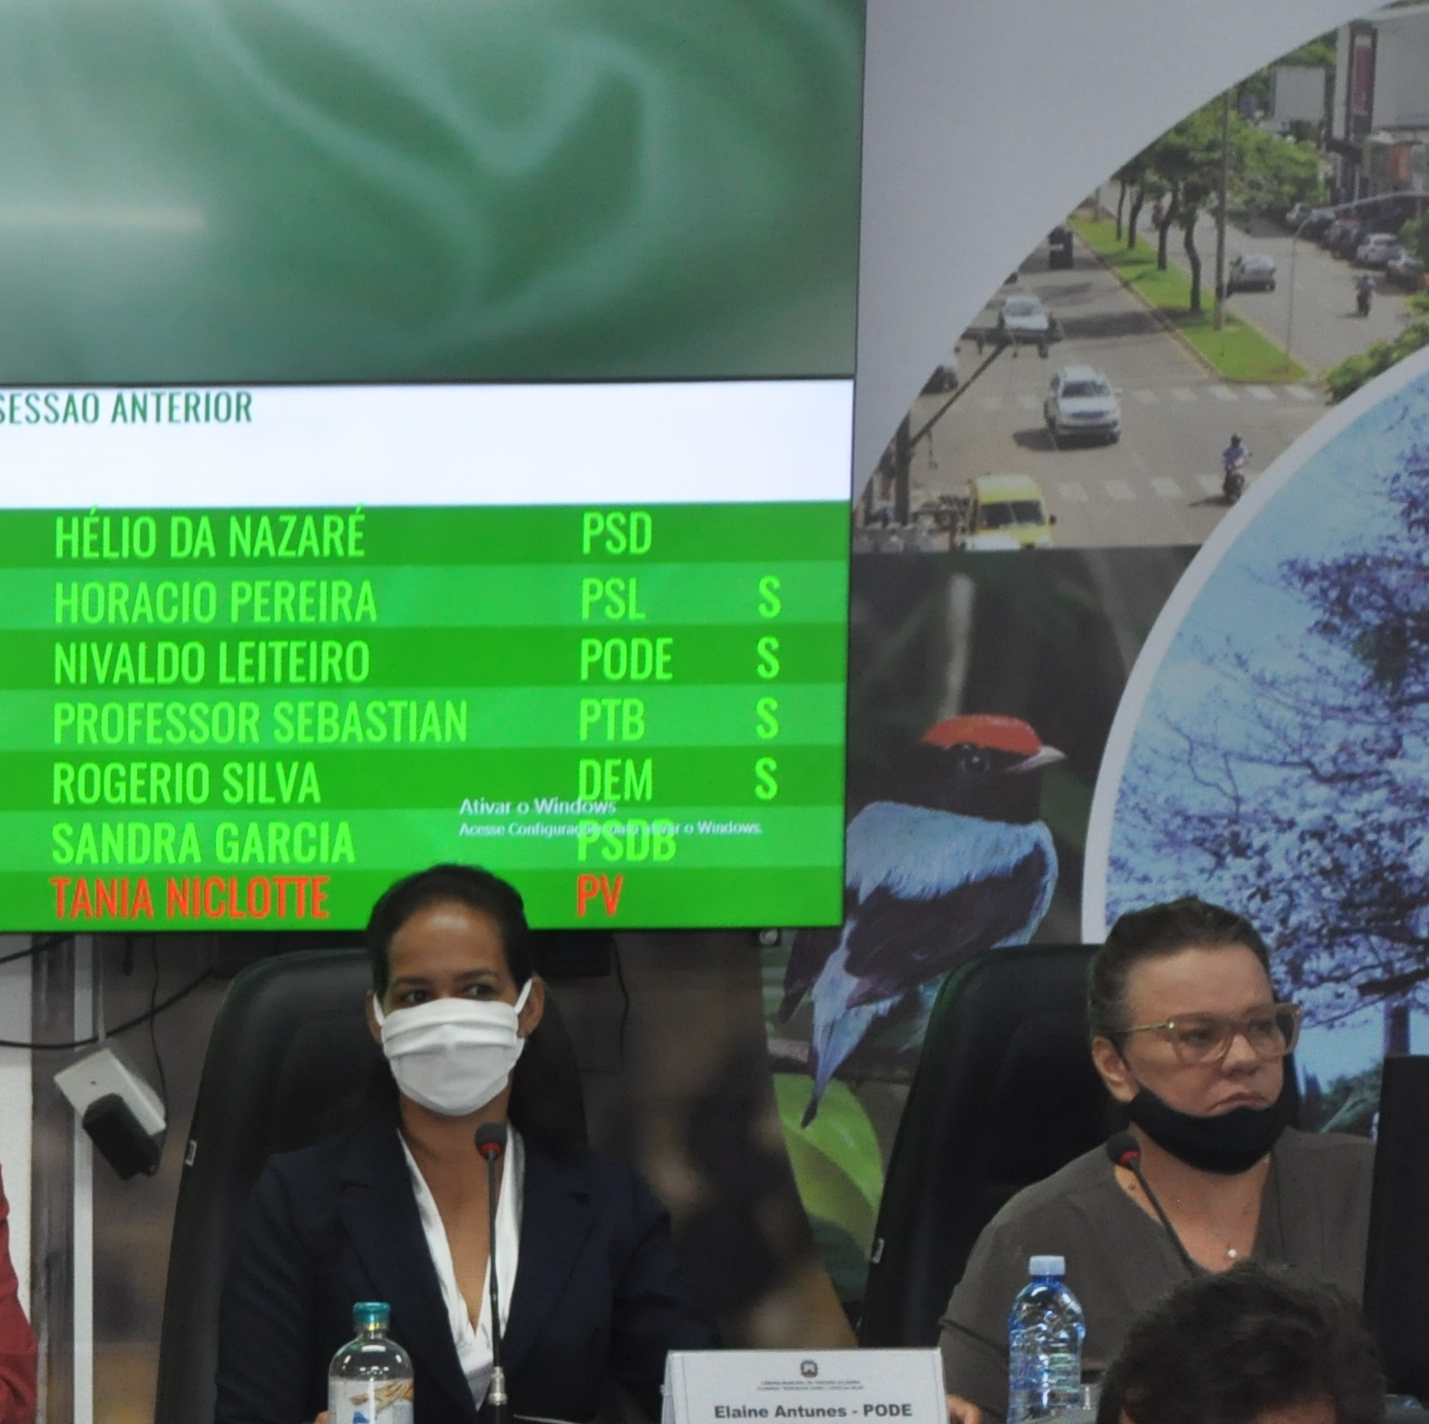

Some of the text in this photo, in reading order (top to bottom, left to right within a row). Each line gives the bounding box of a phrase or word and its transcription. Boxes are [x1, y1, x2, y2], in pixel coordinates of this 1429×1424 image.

[111, 391, 253, 423] ANTERIOR
[55, 503, 366, 558] HÉLIO DA NAZARÉ
[582, 511, 652, 554] PSD
[54, 580, 377, 623] HORACIO PEREIRA
[581, 577, 646, 620] PSL
[758, 575, 781, 618] S
[54, 640, 370, 684] NIVALDO LEITEIRO
[580, 637, 673, 680] PODE
[757, 635, 780, 679] S
[53, 700, 468, 745] PROFESSOR SEBASTIAN
[579, 698, 645, 741] PTB
[756, 697, 779, 739] S
[53, 761, 321, 804] ROGERIO SILVA
[579, 758, 653, 801] DEM
[755, 757, 778, 800] S
[458, 797, 617, 815] Ativar o Windows
[52, 821, 356, 865] SANDRA GARCIA
[458, 822, 505, 836] Acesse
[684, 824, 694, 834] o
[577, 818, 677, 862] PSDB
[50, 876, 330, 919] TANIA NICLOTTE
[577, 873, 624, 917] PV
[714, 1405, 769, 1418] Elaine
[774, 1405, 847, 1418] Antunes
[863, 1404, 913, 1417] PODE
